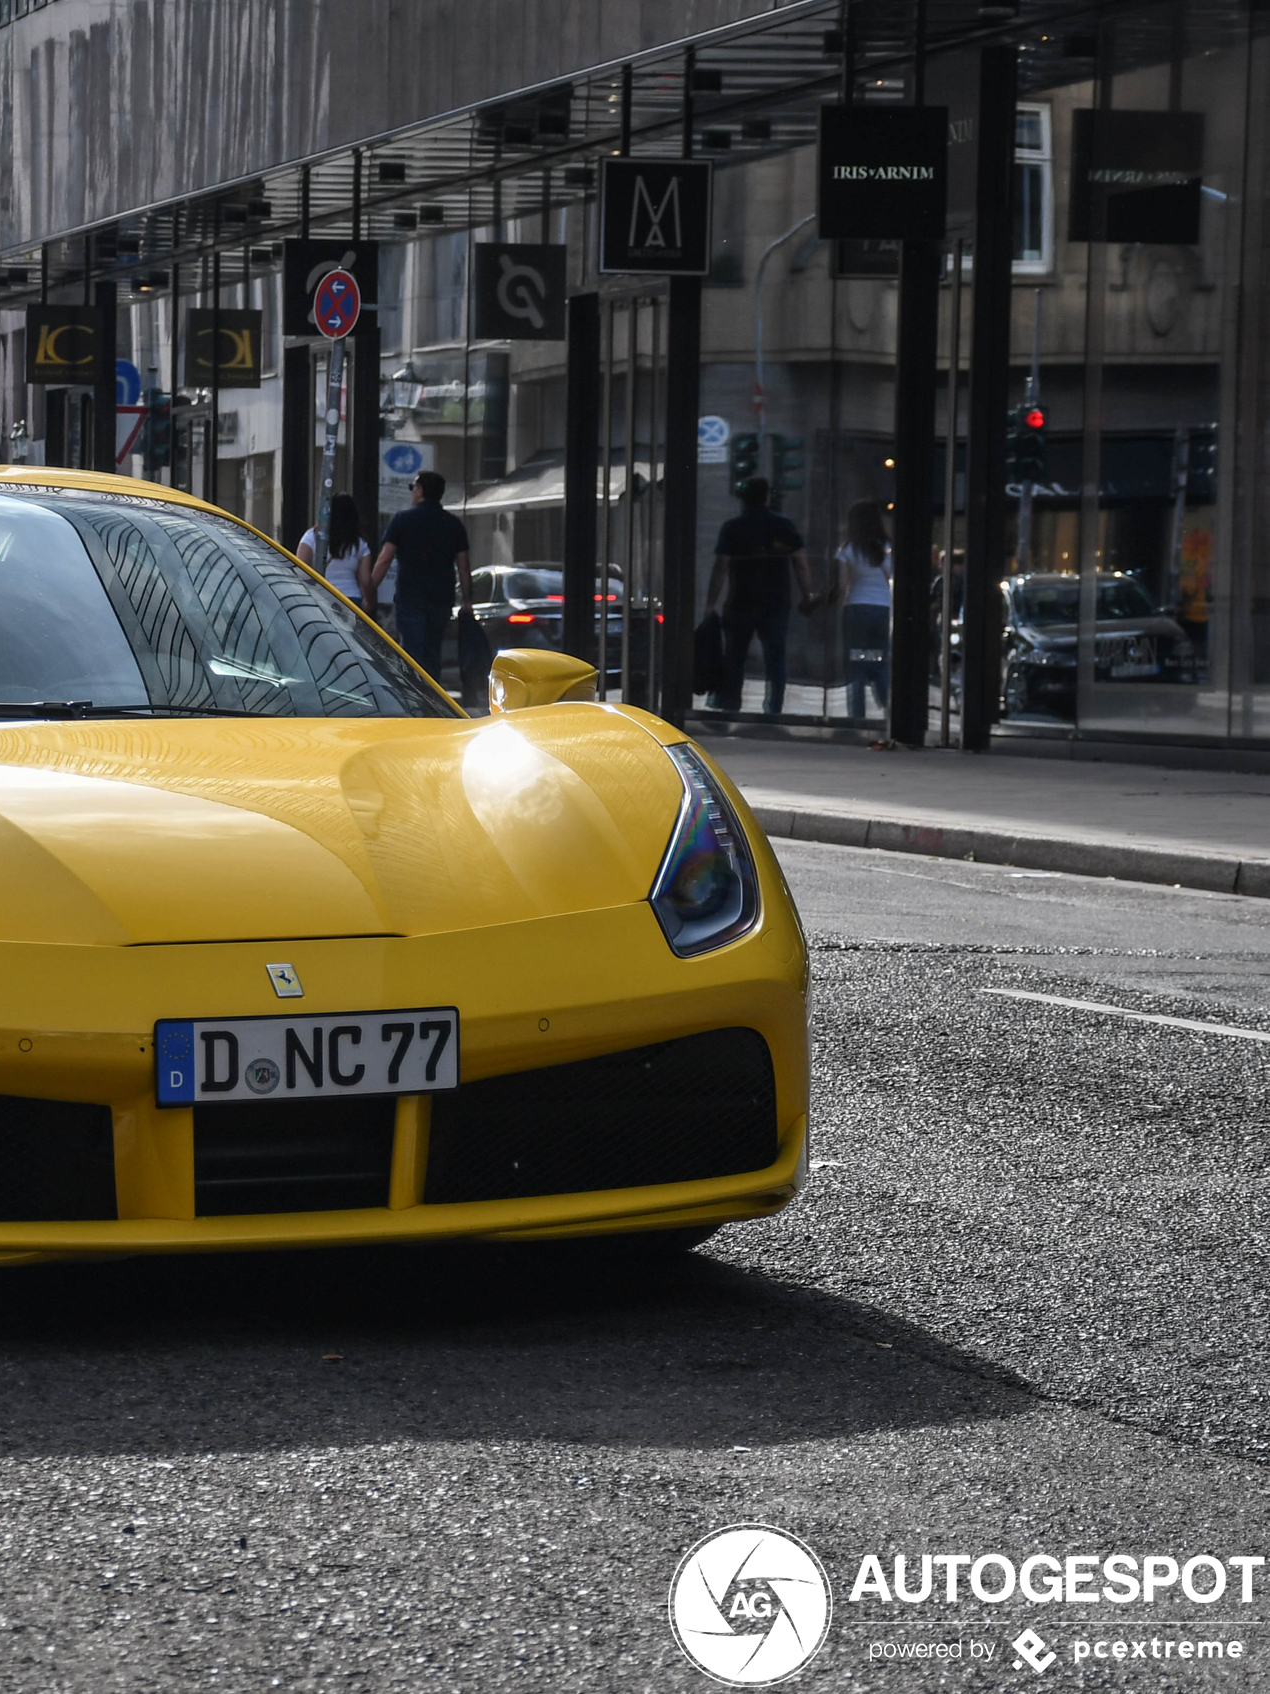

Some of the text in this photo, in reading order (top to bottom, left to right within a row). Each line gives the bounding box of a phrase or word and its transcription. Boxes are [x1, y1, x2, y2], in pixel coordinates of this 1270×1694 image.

[832, 166, 868, 180] IRIS
[875, 166, 934, 180] ARNIM
[200, 1019, 452, 1092] D NC 77
[170, 1071, 183, 1088] D
